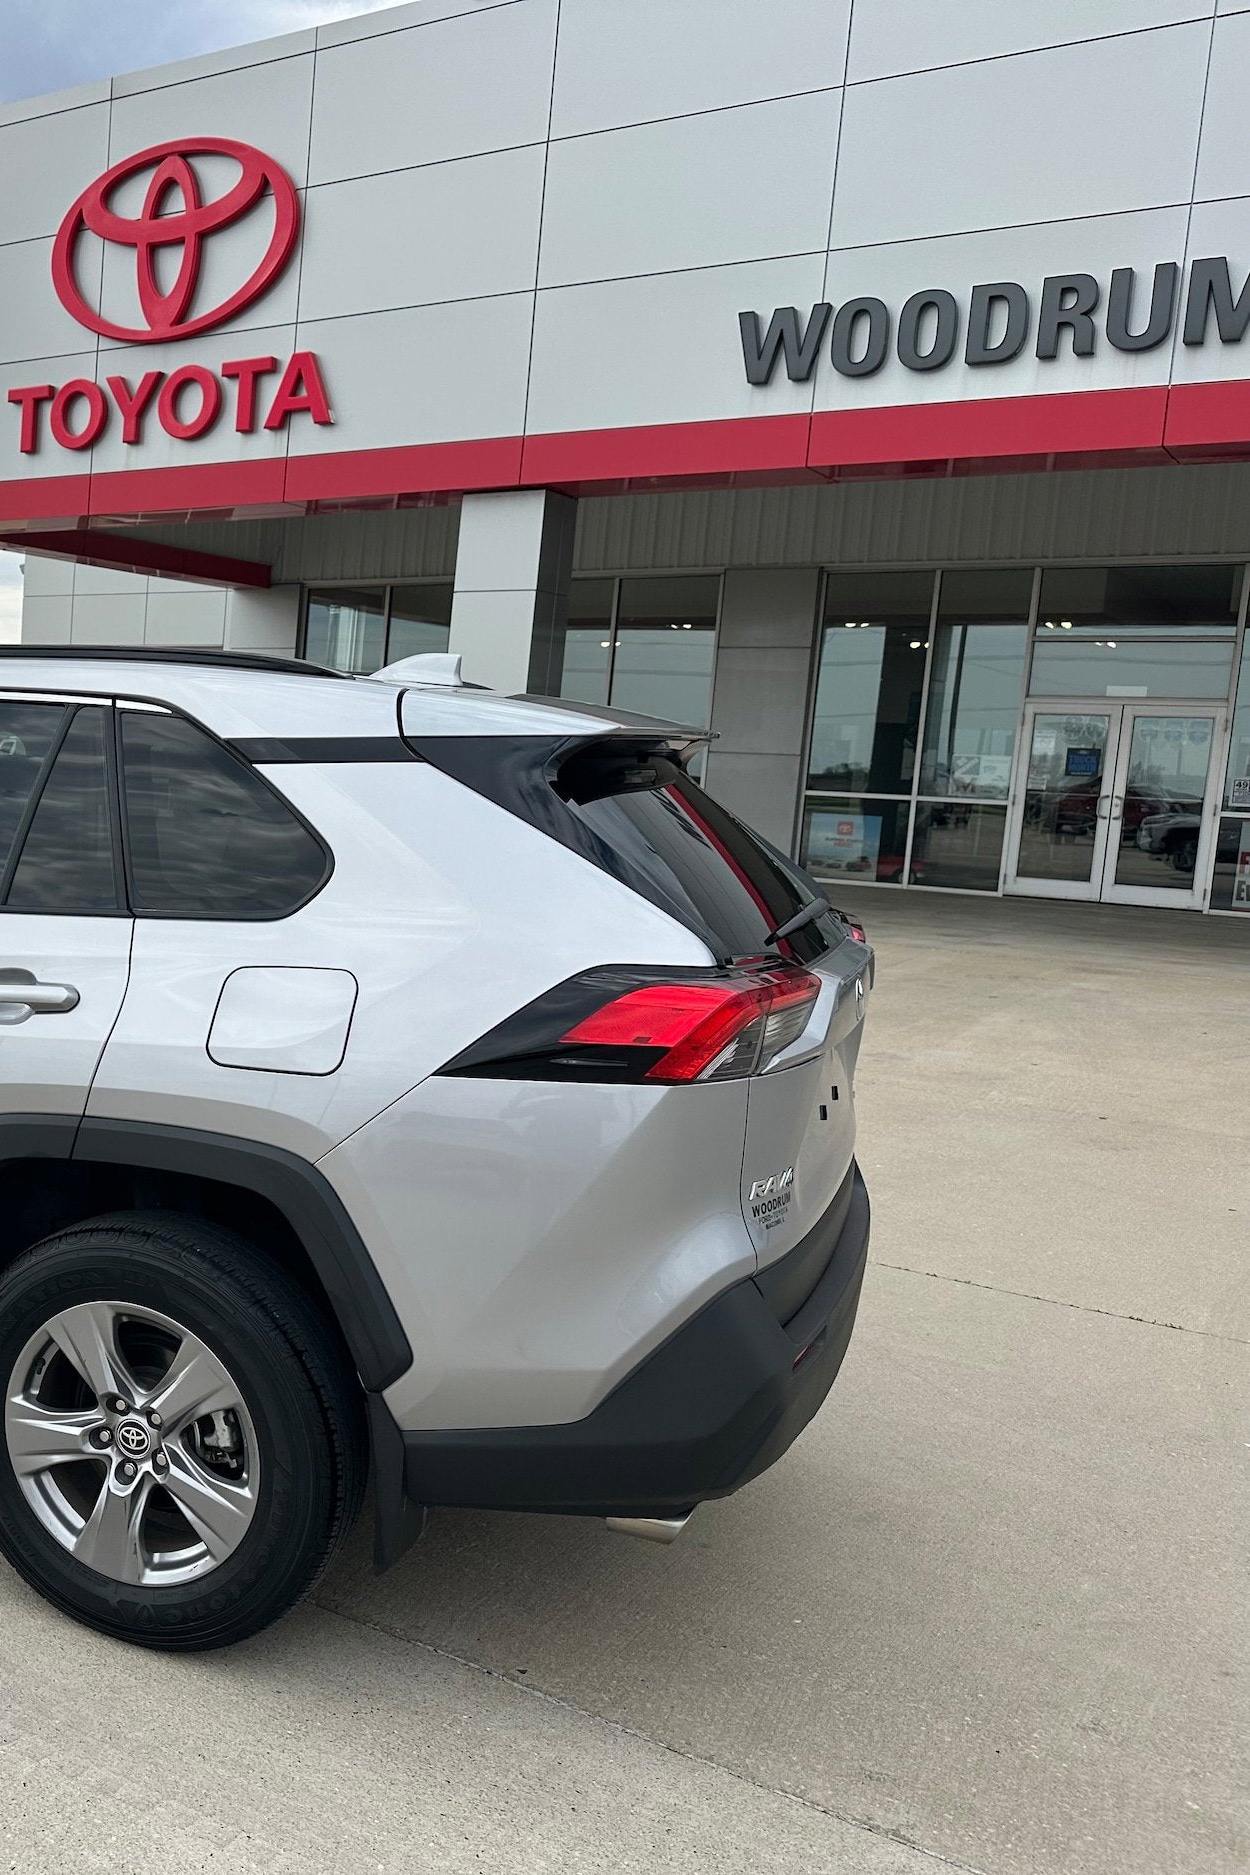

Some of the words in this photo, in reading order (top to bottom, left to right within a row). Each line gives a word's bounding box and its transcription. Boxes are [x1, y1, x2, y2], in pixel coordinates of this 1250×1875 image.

[739, 257, 1250, 386] WOODRUM
[8, 351, 334, 454] TOYOTA
[751, 1192, 791, 1218] WOODRUM
